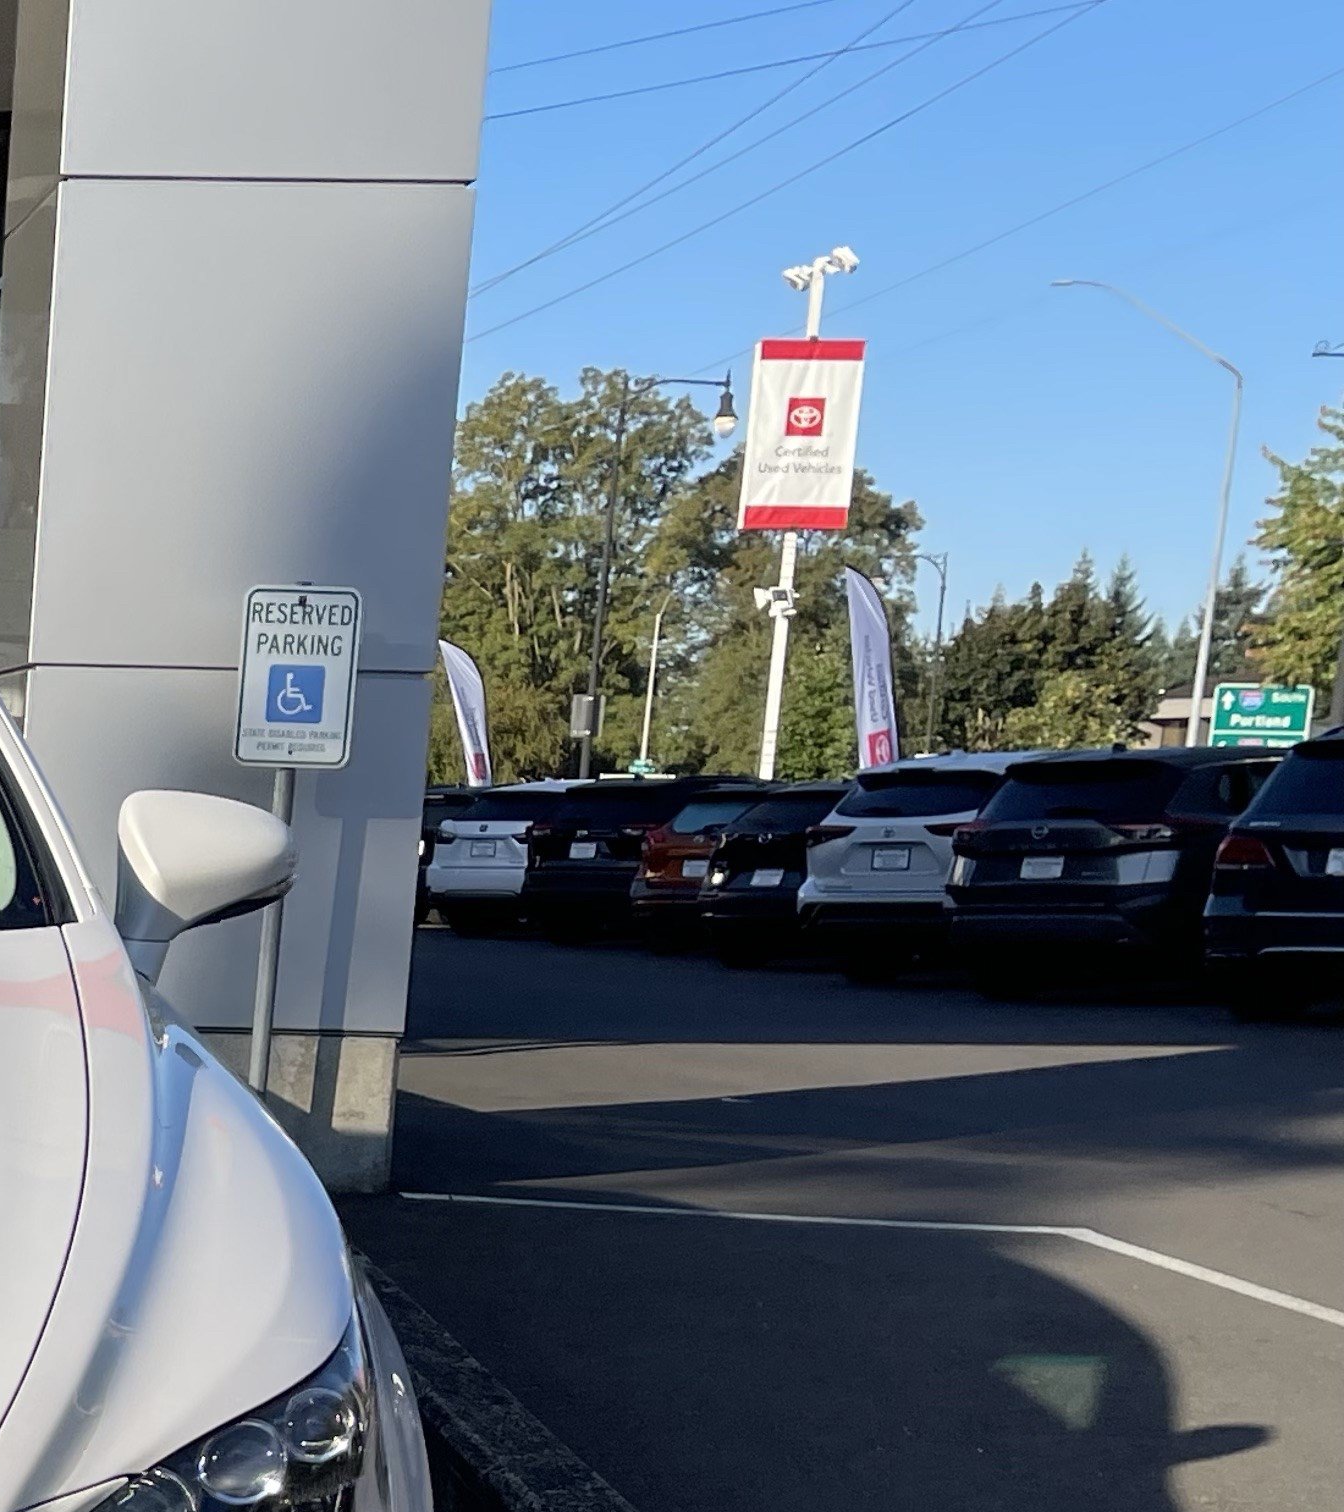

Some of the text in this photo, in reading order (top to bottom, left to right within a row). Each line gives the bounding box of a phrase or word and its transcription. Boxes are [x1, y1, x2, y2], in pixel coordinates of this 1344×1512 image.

[774, 446, 830, 457] Certified
[758, 462, 842, 474] Used Vehicles
[251, 602, 353, 626] RESERVED
[256, 632, 343, 656] PARKING
[1229, 713, 1291, 728] Portland
